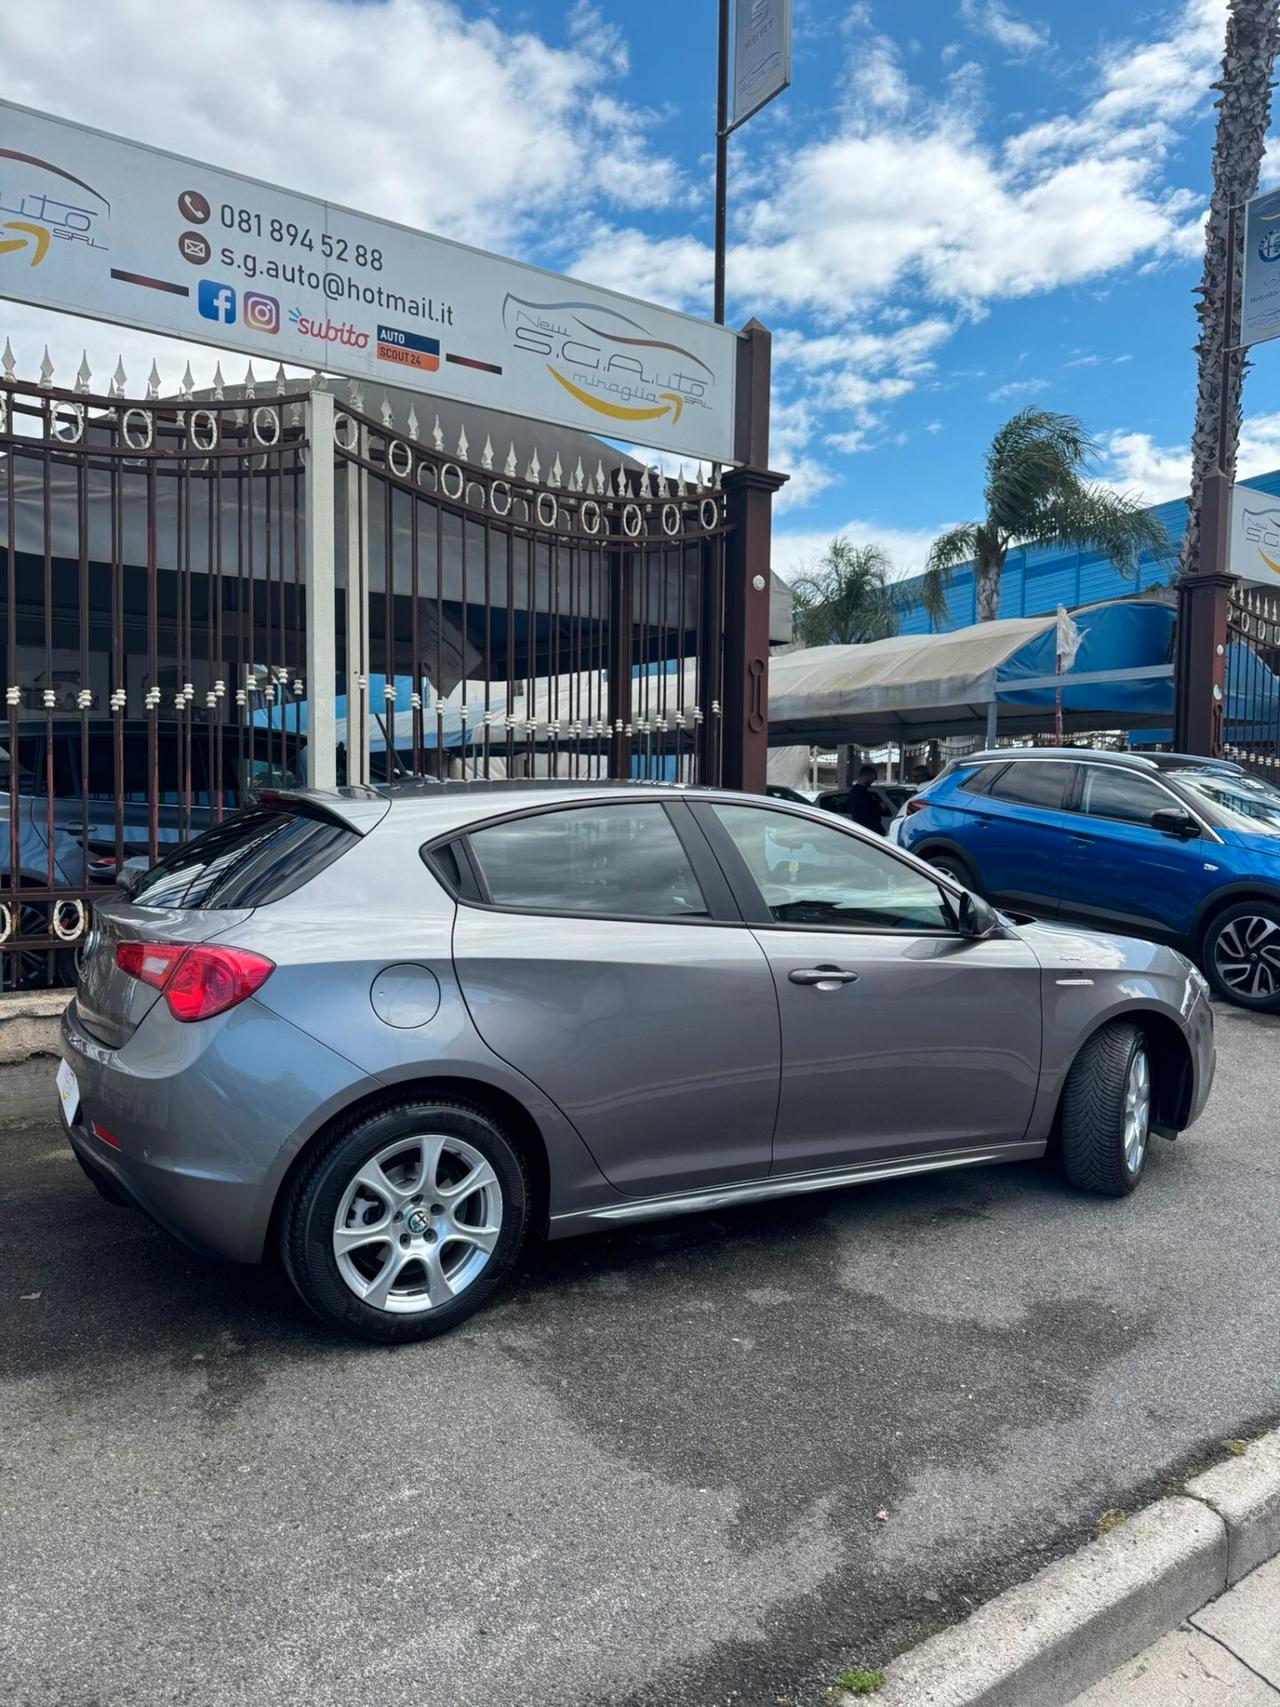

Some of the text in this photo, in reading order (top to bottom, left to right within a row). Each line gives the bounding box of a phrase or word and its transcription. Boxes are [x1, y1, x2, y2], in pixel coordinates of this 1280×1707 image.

[221, 204, 383, 271] 081 894 52 88
[221, 248, 453, 326] s.g.auto@hotmail.it
[297, 318, 370, 349] subito
[380, 328, 405, 345] AUTO
[516, 309, 571, 337] New
[379, 346, 421, 367] SCOUT 24
